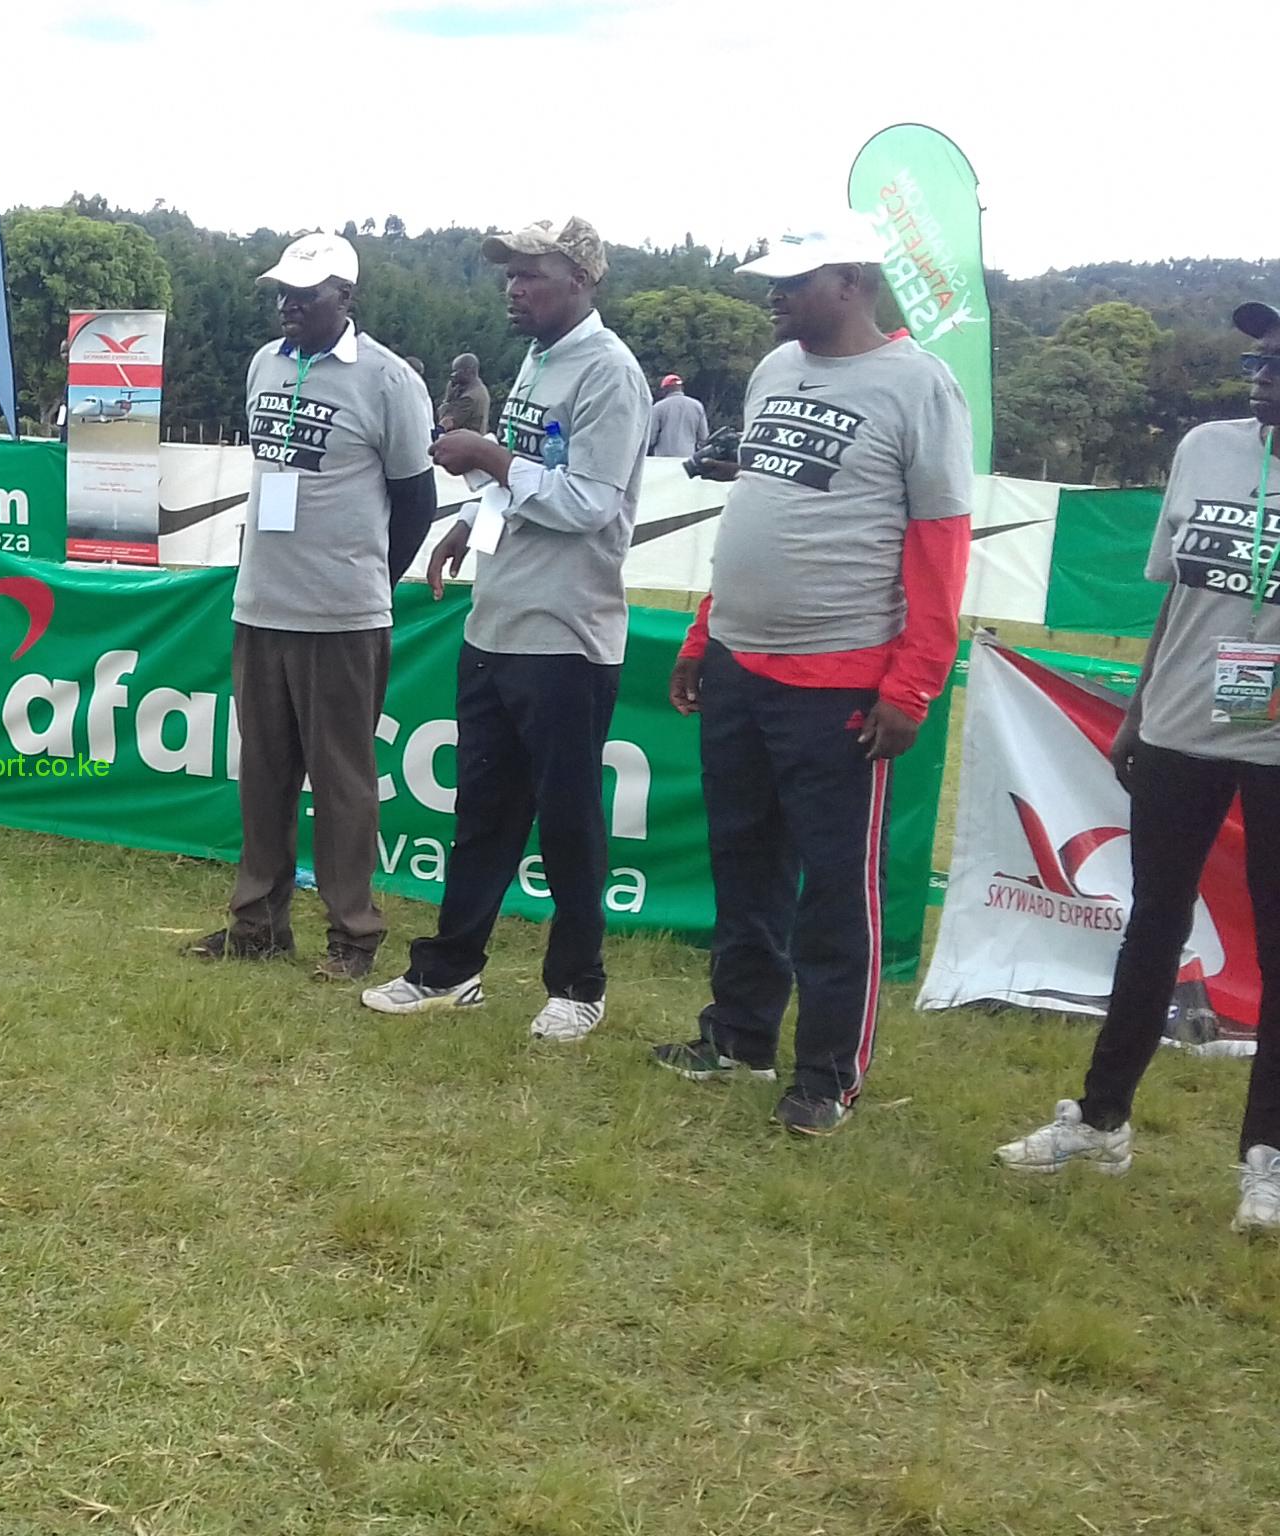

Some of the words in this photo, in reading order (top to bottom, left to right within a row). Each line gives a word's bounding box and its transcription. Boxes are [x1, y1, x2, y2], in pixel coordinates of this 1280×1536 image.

[259, 396, 332, 420] NDALAT
[763, 400, 858, 432] NDALAT
[269, 421, 295, 437] XC
[771, 427, 807, 447] XC
[257, 443, 298, 462] 2017
[751, 453, 803, 477] 2017
[1195, 505, 1280, 534] NDAL
[984, 884, 1055, 918] SKYWARD
[1059, 900, 1123, 931] EXPRESS
